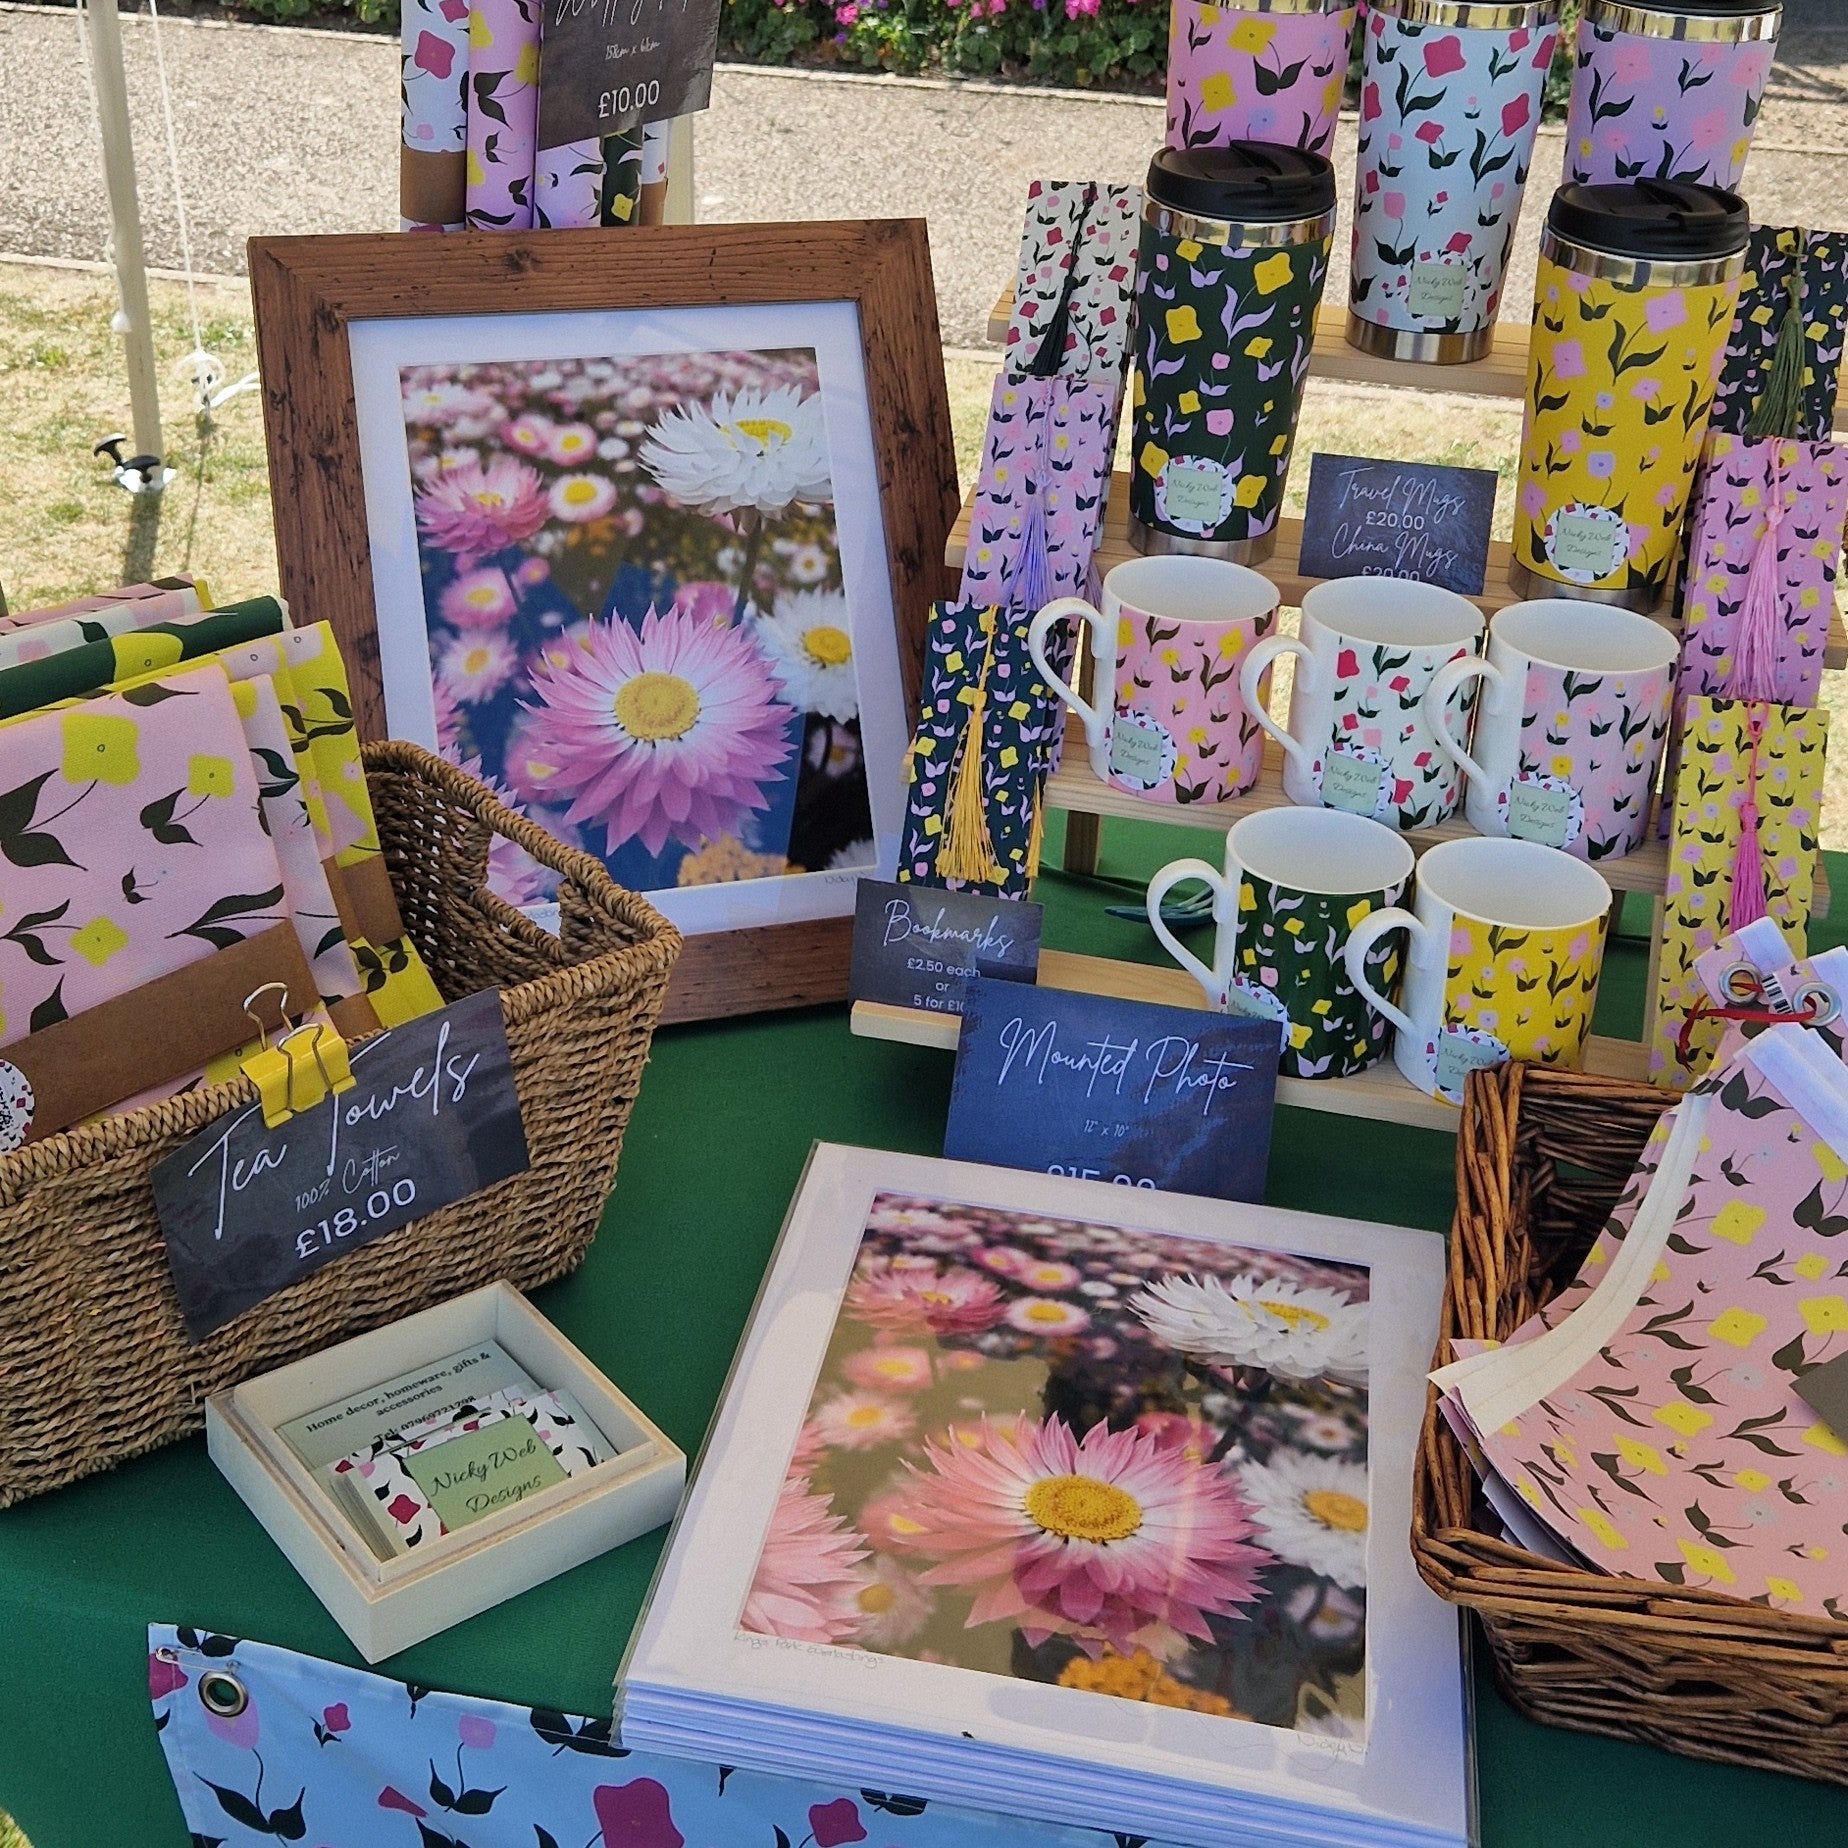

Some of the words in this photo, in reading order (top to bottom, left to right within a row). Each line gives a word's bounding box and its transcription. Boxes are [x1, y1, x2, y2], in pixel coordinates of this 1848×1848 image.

[598, 79, 660, 118] £10.00
[1339, 466, 1402, 510] Travel
[1402, 477, 1466, 524] Mugs
[1365, 510, 1425, 531] £20.00
[1331, 522, 1389, 559] China
[1395, 530, 1458, 577] Mugs
[882, 898, 1015, 958] Bookmarks
[906, 957, 943, 973] £2.50
[946, 965, 981, 978] each
[935, 982, 950, 993] or
[913, 993, 922, 1006] 5
[925, 995, 944, 1009] for
[998, 1017, 1139, 1099] Mounted
[1143, 1035, 1255, 1116] Photo
[188, 1103, 287, 1240] Tea
[327, 1021, 480, 1177] Towels
[295, 1178, 331, 1213] 100%
[342, 1145, 400, 1194] Cotton
[294, 1178, 416, 1259] £18.00
[306, 1413, 344, 1433] Home
[345, 1397, 385, 1416] decor,
[383, 1370, 452, 1400] homeware,
[452, 1357, 479, 1374] gifts
[480, 1351, 491, 1360] &
[376, 1384, 443, 1417] accessories
[465, 1474, 541, 1513] Designs
